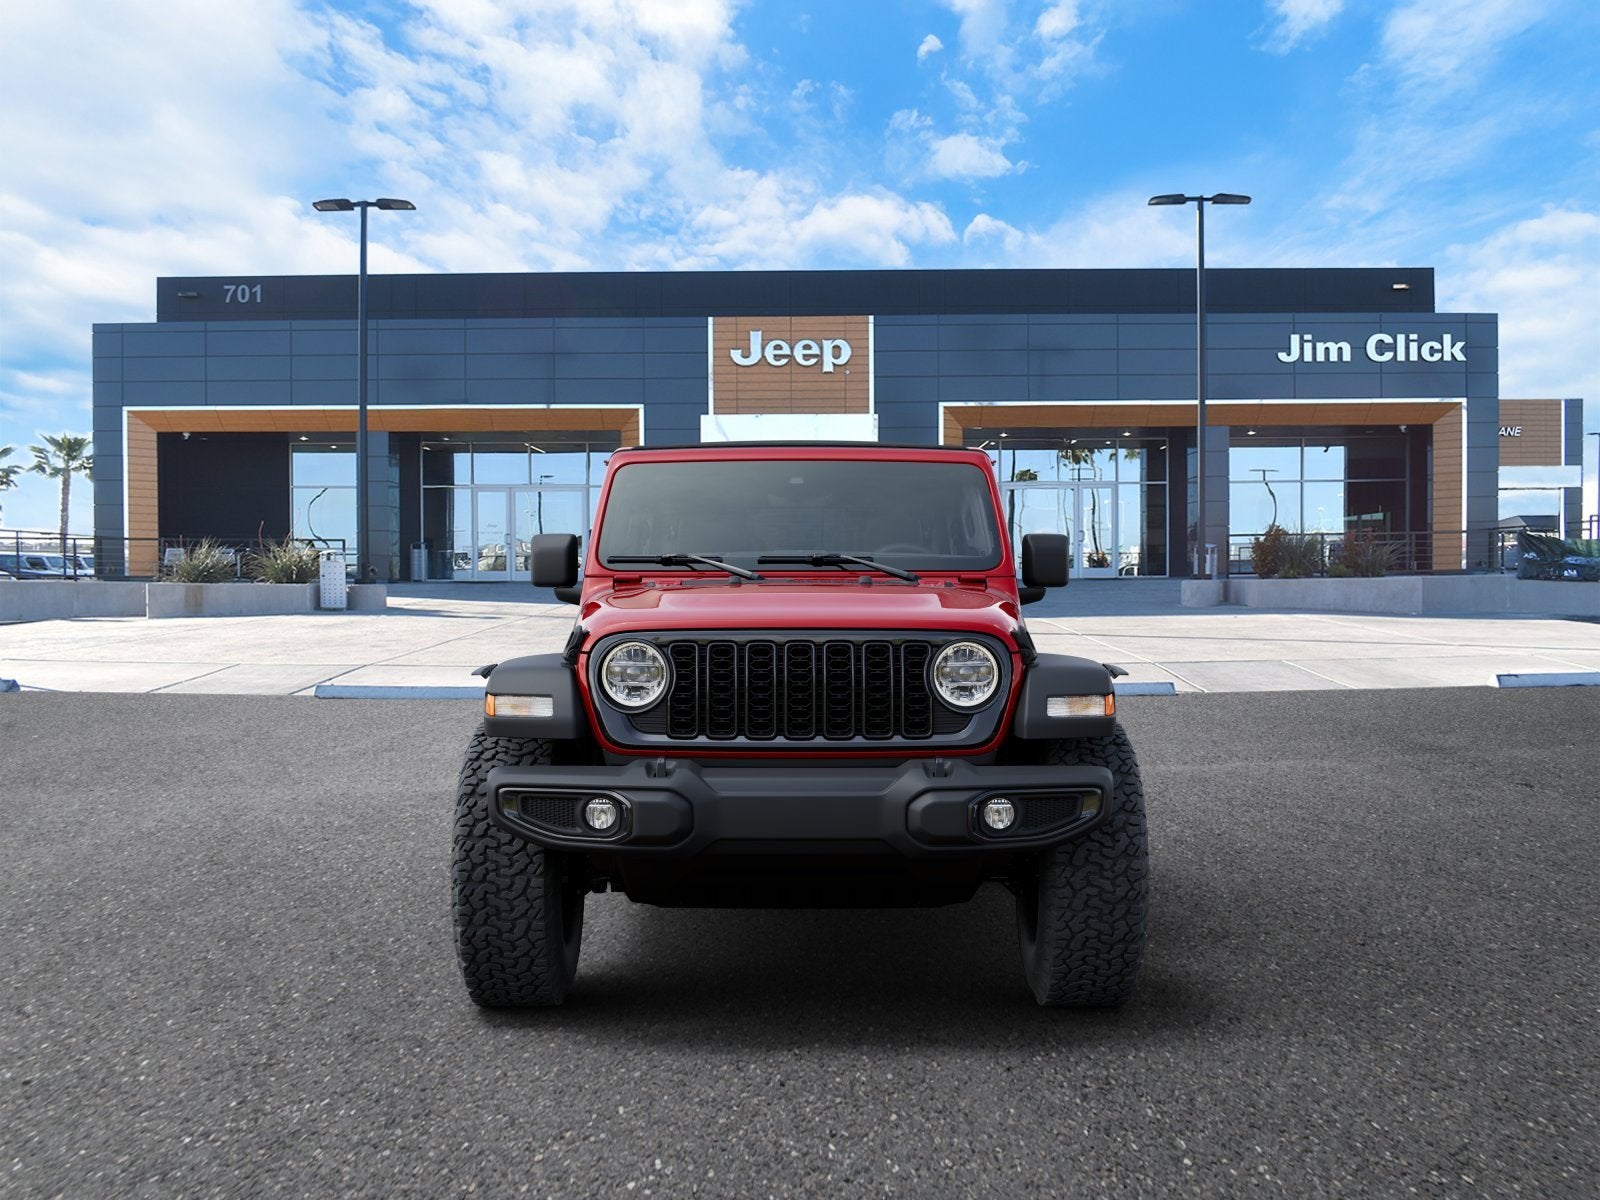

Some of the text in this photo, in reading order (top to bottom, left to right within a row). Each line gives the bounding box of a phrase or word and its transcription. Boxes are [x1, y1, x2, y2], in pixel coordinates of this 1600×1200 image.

[223, 284, 262, 303] 701
[729, 330, 852, 373] Jeep
[1277, 333, 1467, 363] Jim Click
